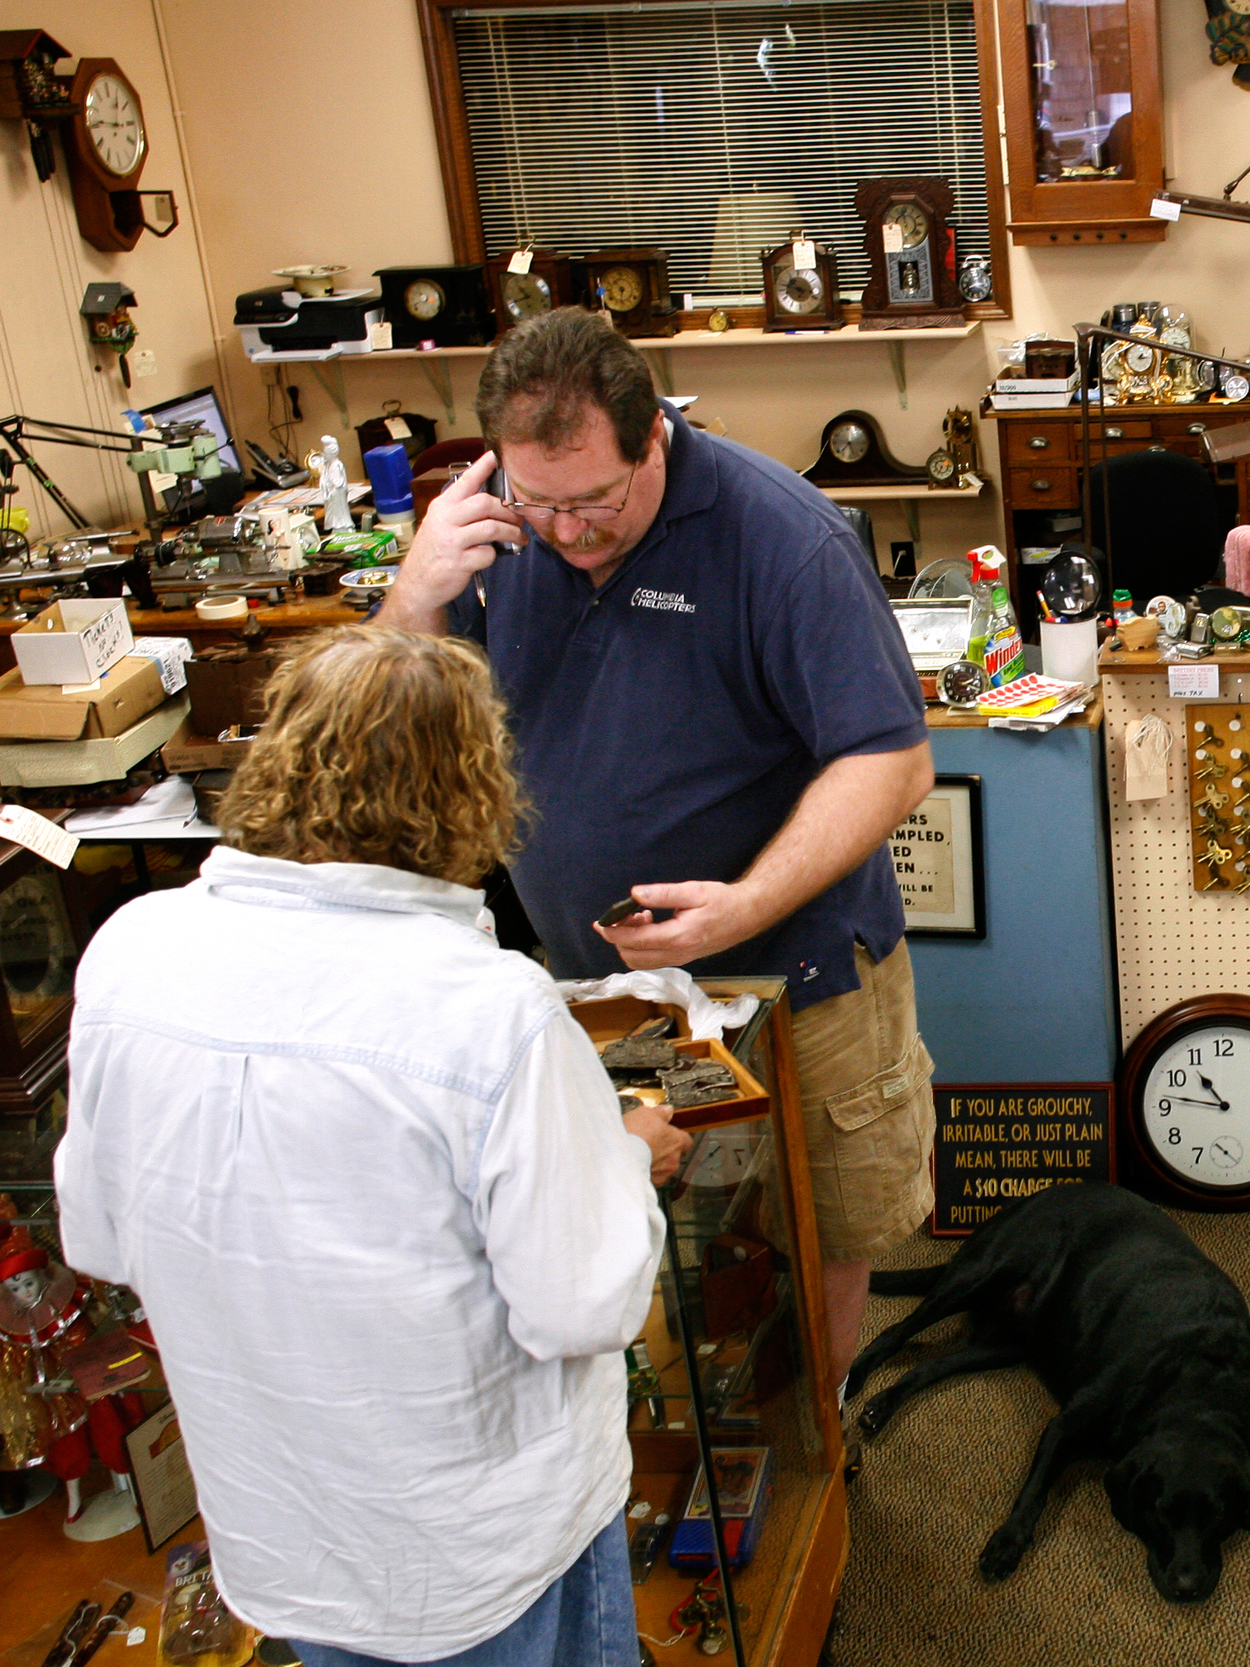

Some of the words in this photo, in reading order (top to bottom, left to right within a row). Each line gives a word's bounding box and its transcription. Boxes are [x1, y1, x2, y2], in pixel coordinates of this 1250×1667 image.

[641, 589, 685, 603] COLUMBIA
[638, 598, 696, 613] HELICOPTERS
[985, 638, 1023, 677] Winde
[1187, 1048, 1202, 1066] 11
[1213, 1039, 1234, 1057] 12
[1166, 1069, 1187, 1087] 10
[951, 1098, 963, 1118] IF
[967, 1099, 995, 1116] YOU
[998, 1098, 1024, 1116] ARE
[1027, 1098, 1092, 1117] GROUCHY,
[1158, 1099, 1171, 1117] 9
[943, 1124, 1009, 1143] IRRITABLE,
[1011, 1124, 1032, 1141] OR
[1035, 1124, 1062, 1141] JUST
[1065, 1123, 1103, 1141] PLAIN
[1168, 1127, 1181, 1145] 8
[955, 1150, 996, 1169] MEAN,
[1000, 1150, 1039, 1168] THERE
[1042, 1150, 1074, 1168] WILL
[1077, 1149, 1091, 1167] BE
[1191, 1147, 1204, 1165] 7
[963, 1179, 973, 1196] A
[975, 1177, 999, 1199] $10
